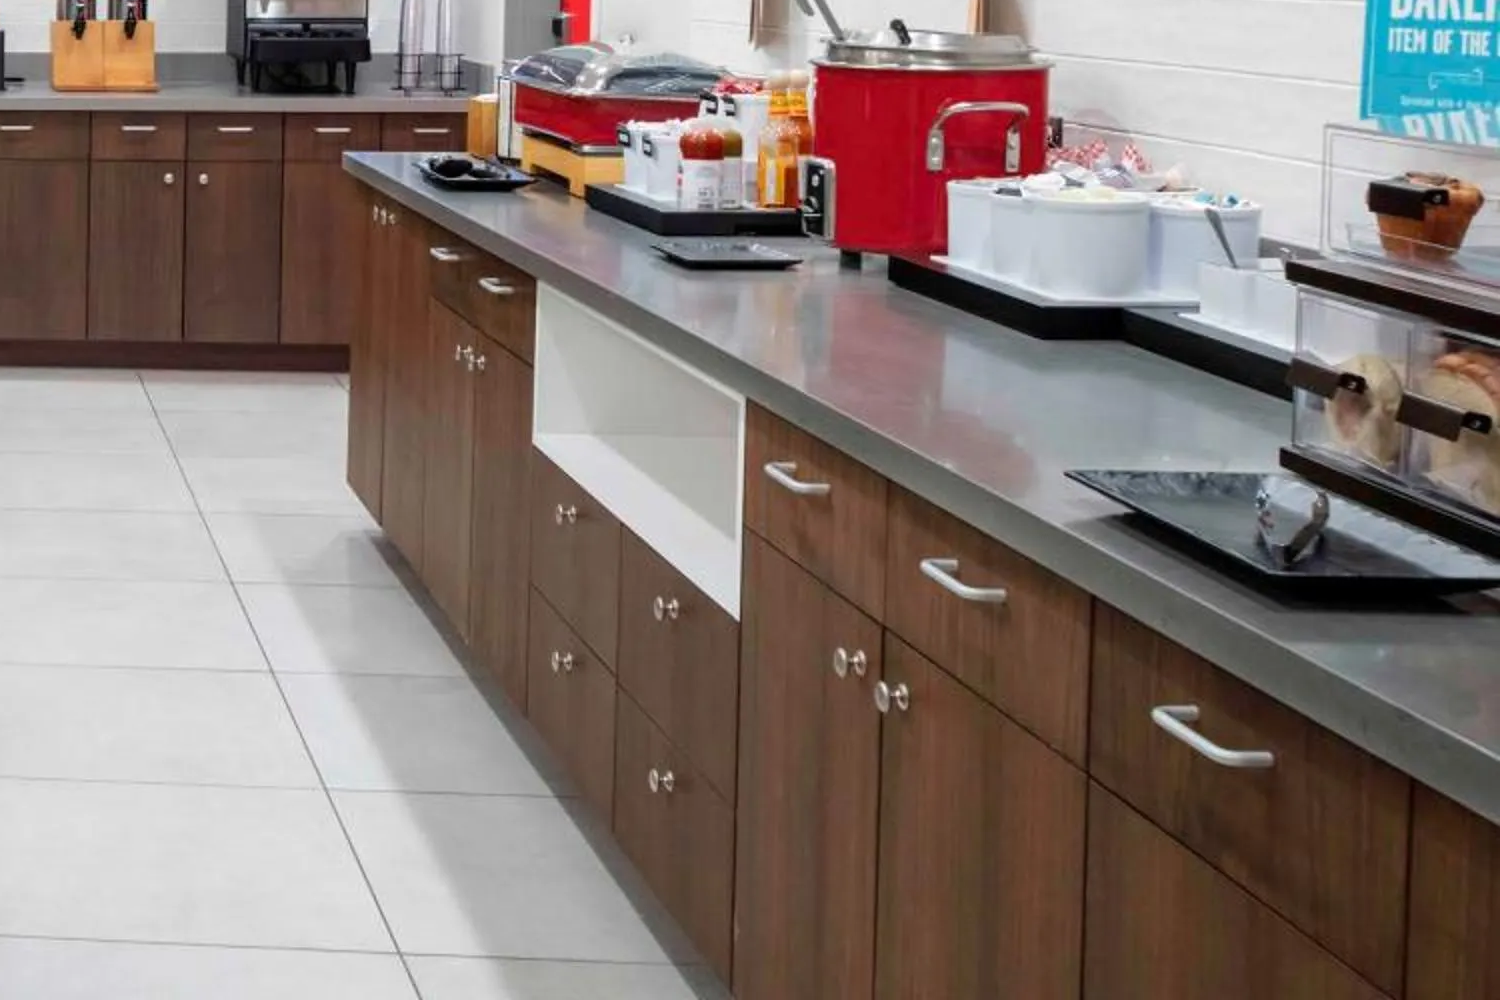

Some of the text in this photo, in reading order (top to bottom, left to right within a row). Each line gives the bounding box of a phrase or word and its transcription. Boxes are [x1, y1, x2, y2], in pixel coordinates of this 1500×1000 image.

[1387, 27, 1427, 53] ITEM
[1432, 28, 1455, 55] OF
[1460, 29, 1492, 56] THE
